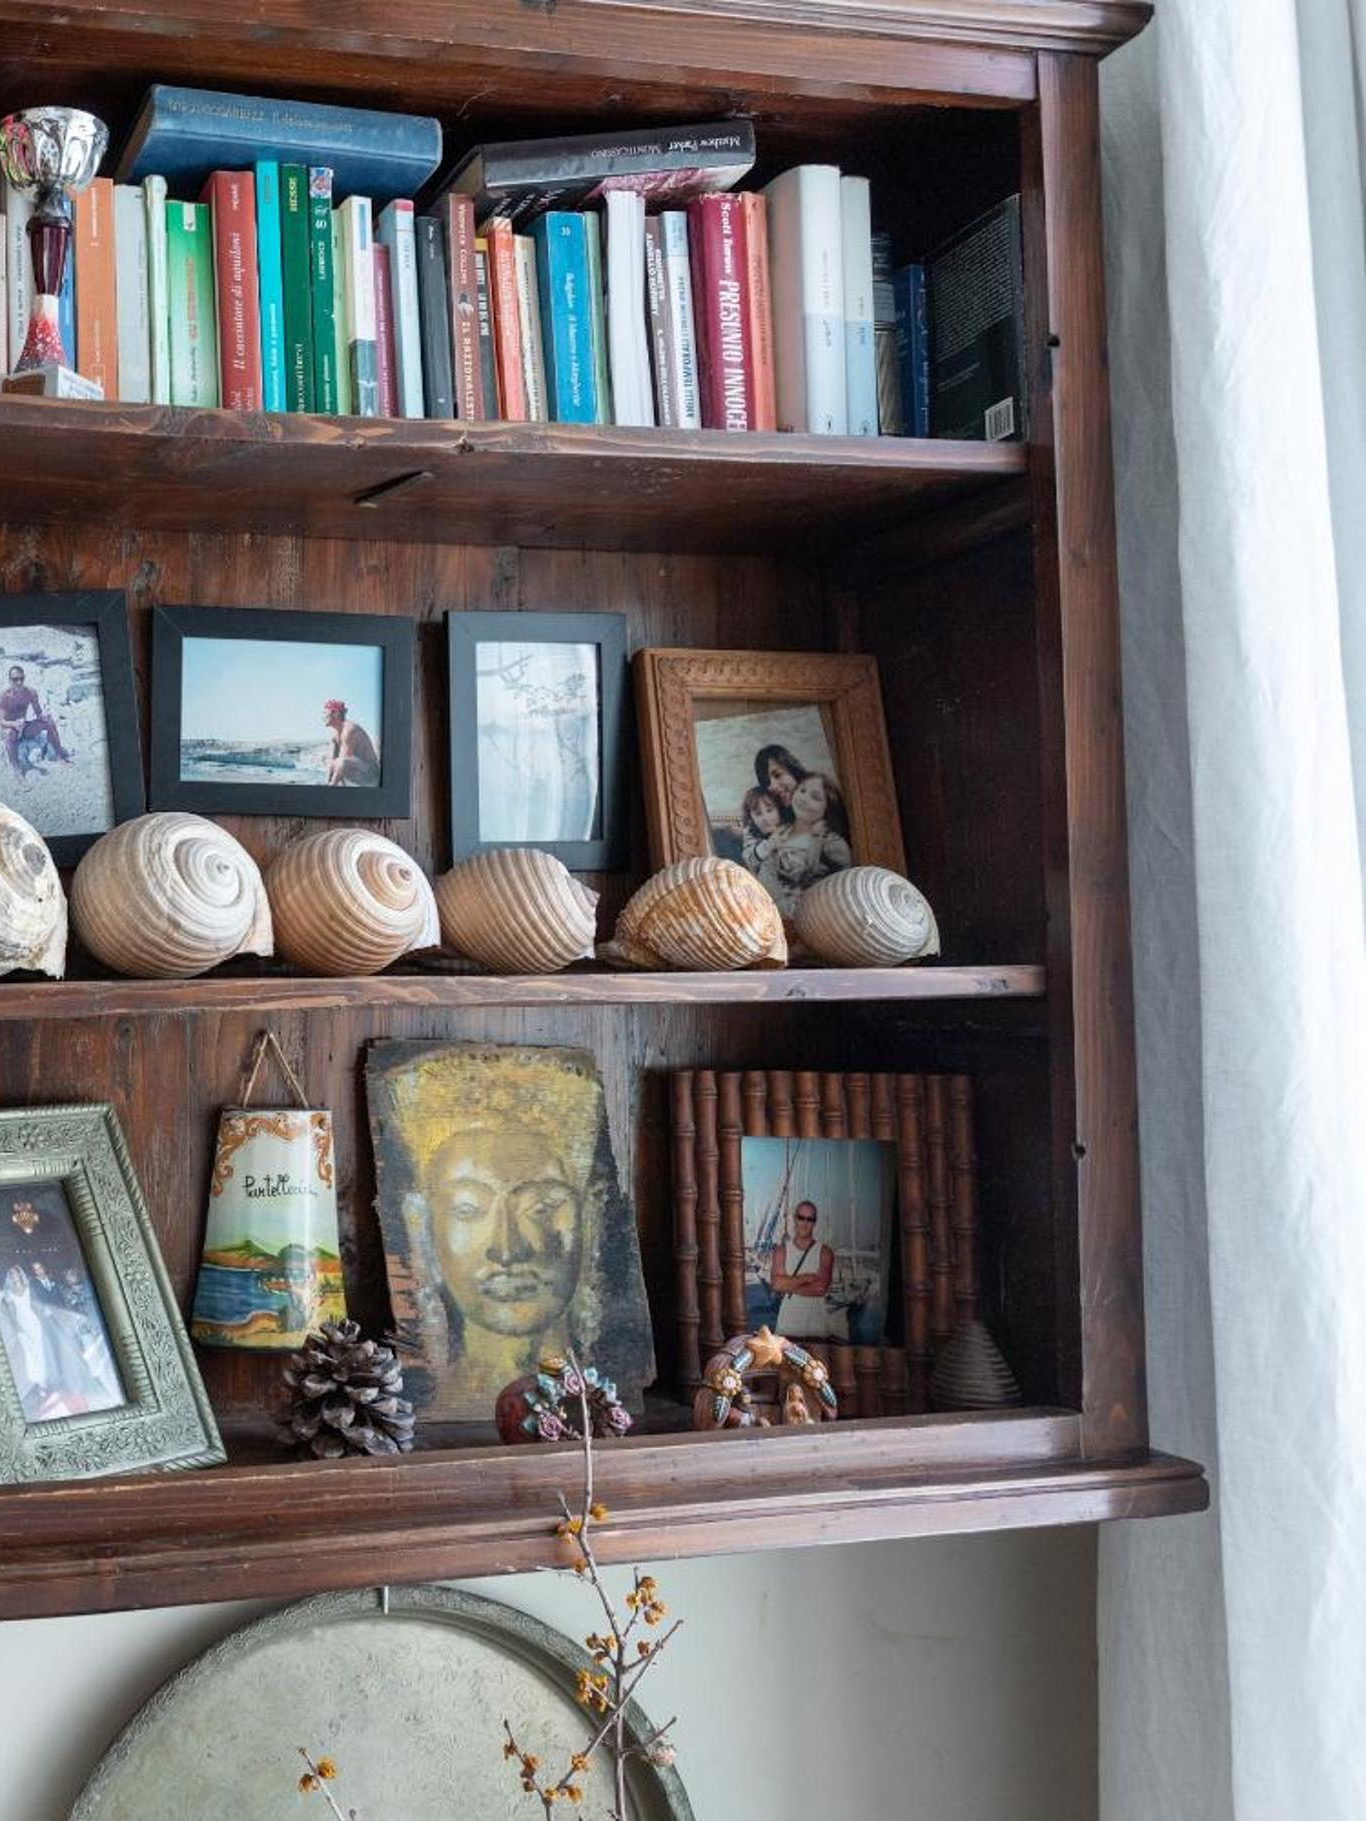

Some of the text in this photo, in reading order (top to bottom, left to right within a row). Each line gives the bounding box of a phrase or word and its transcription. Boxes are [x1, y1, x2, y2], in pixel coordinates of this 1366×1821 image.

[667, 139, 699, 153] Parker
[698, 135, 741, 150] Matthew
[720, 201, 735, 275] Scott Turow
[459, 248, 470, 285] COLLINS
[228, 232, 246, 371] Il cacciatore di aquiloni
[461, 321, 471, 333] IL
[718, 279, 748, 432] PRESUNTO INNOCE
